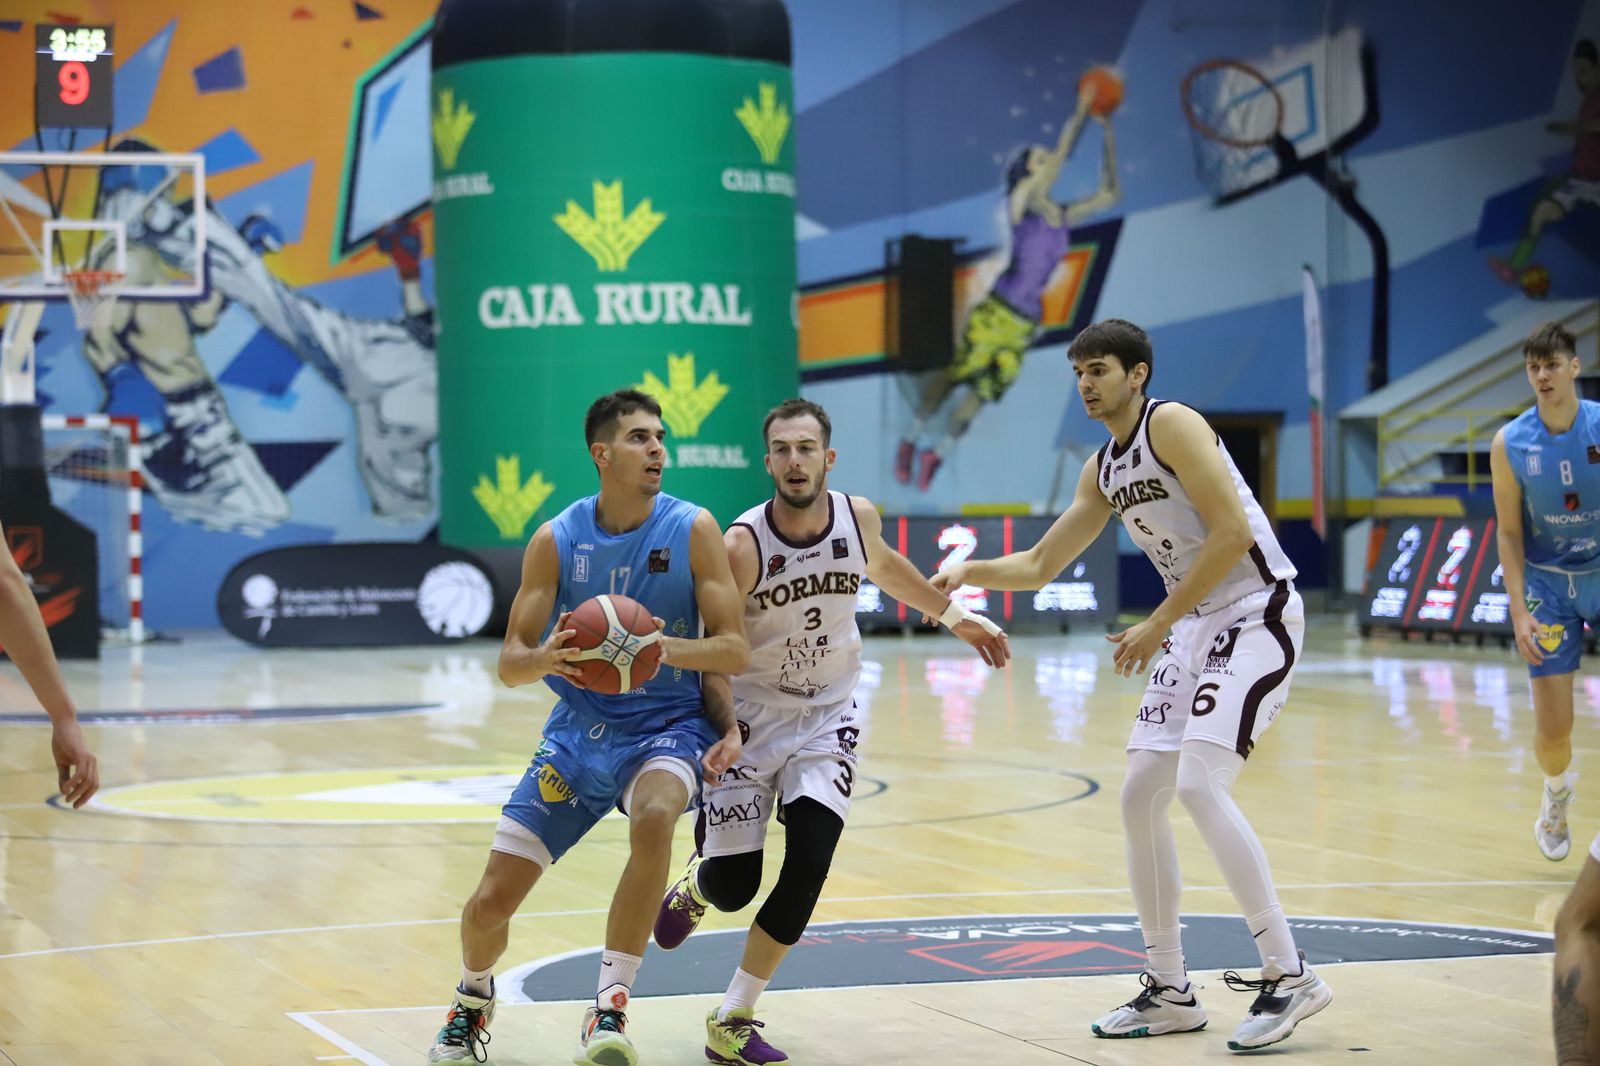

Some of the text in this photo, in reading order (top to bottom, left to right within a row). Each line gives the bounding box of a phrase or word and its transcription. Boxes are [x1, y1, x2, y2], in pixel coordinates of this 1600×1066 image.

[58, 61, 91, 105] 9
[479, 282, 751, 328] CAJA RURAL
[677, 444, 749, 468] RURAL
[1560, 460, 1574, 486] 8
[1134, 518, 1154, 536] 6
[610, 567, 631, 595] 17
[754, 571, 860, 610] TORMES
[804, 607, 822, 631] 3
[785, 637, 808, 648] LA
[1191, 682, 1220, 717] 6
[530, 766, 579, 808] ZAMORA
[833, 761, 853, 798] 3
